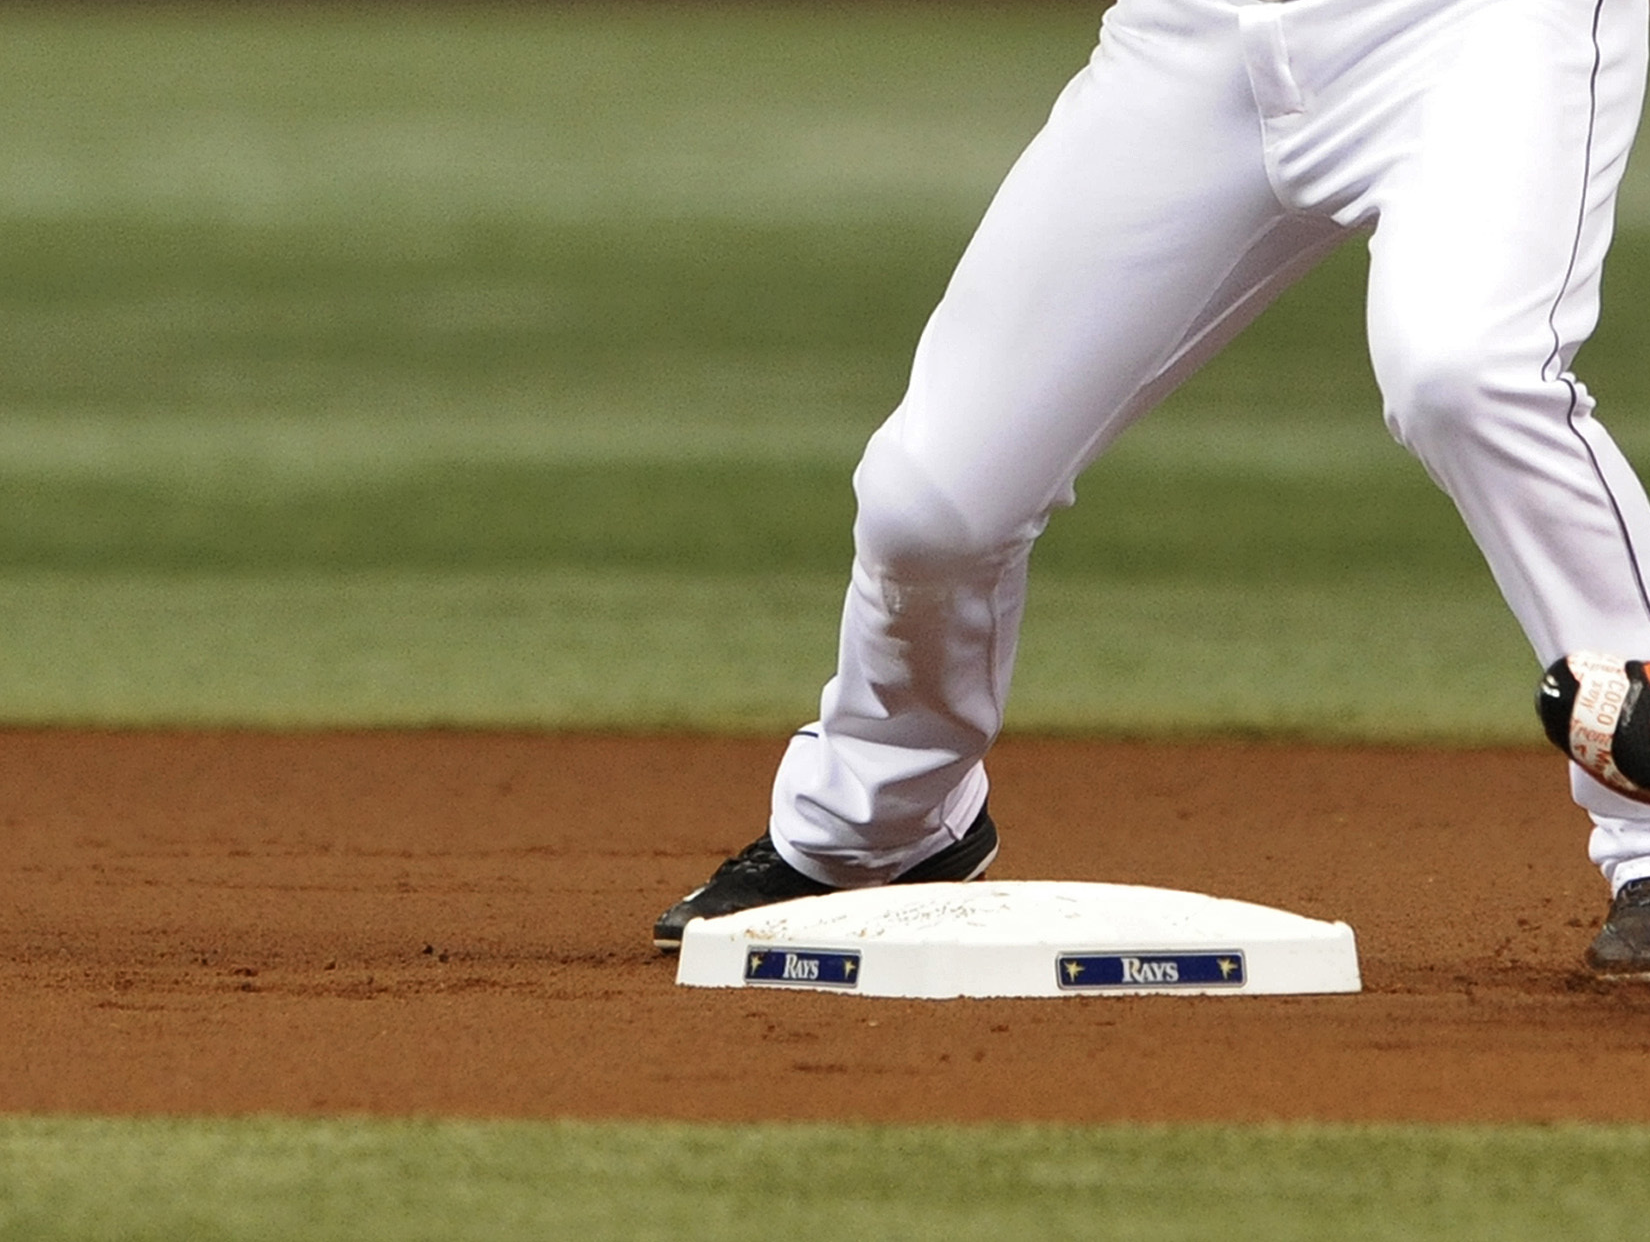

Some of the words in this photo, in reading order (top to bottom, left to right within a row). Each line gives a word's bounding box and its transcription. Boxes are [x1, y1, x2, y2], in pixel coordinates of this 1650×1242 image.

[1596, 679, 1626, 726] COCO
[782, 953, 819, 980] RAYS
[1120, 956, 1180, 983] RAYS
